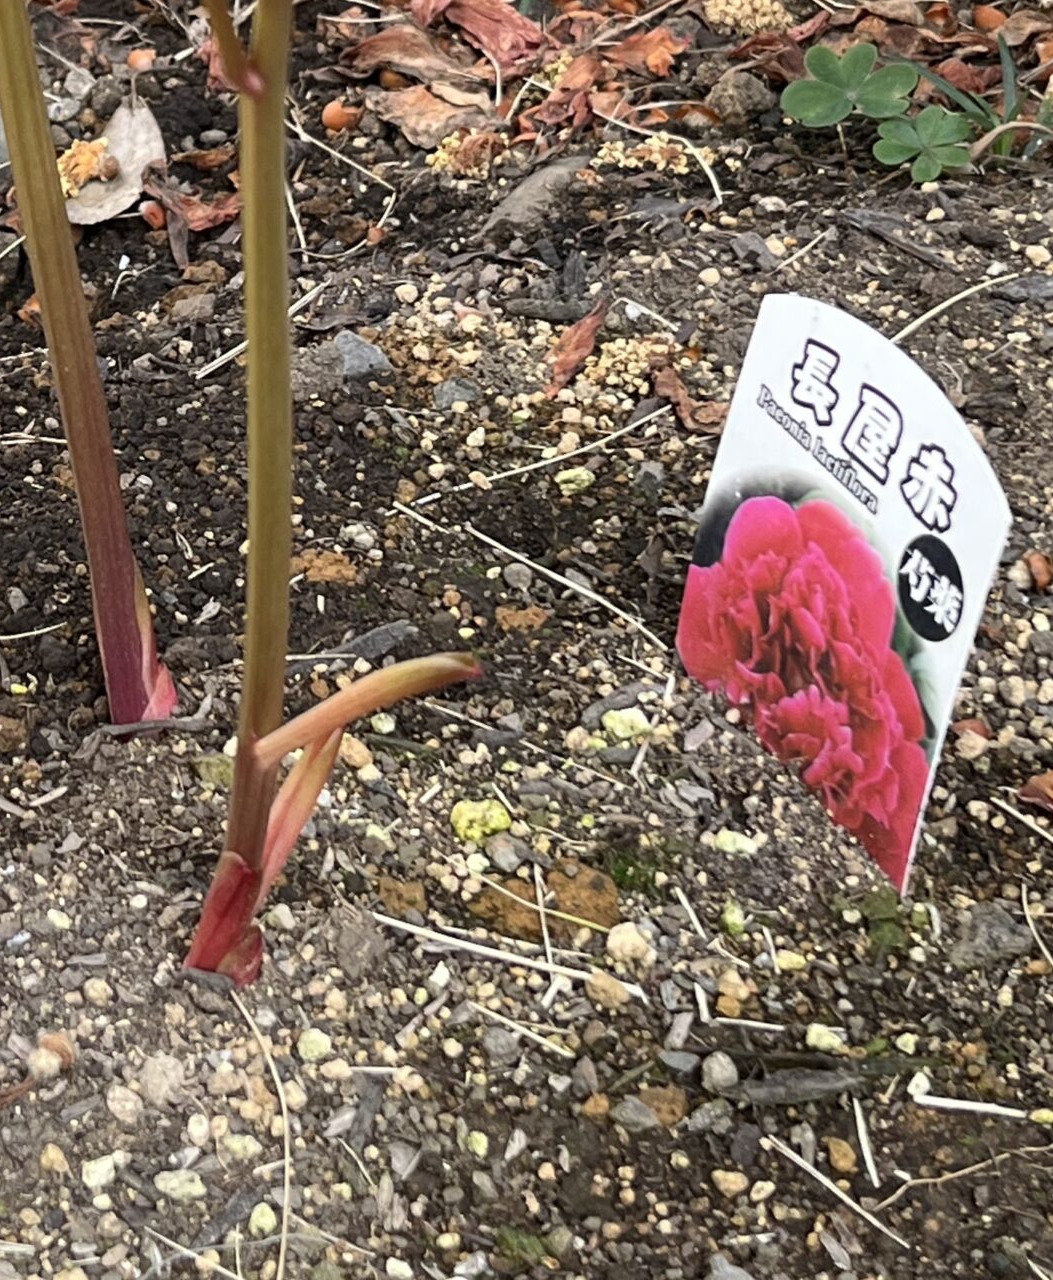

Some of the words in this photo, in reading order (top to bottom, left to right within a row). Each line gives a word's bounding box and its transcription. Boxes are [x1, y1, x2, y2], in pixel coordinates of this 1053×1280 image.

[756, 383, 811, 451] Paeonia
[811, 435, 878, 515] lactiflora
[791, 338, 957, 533] 長屋赤
[899, 548, 964, 634] 芍薬
